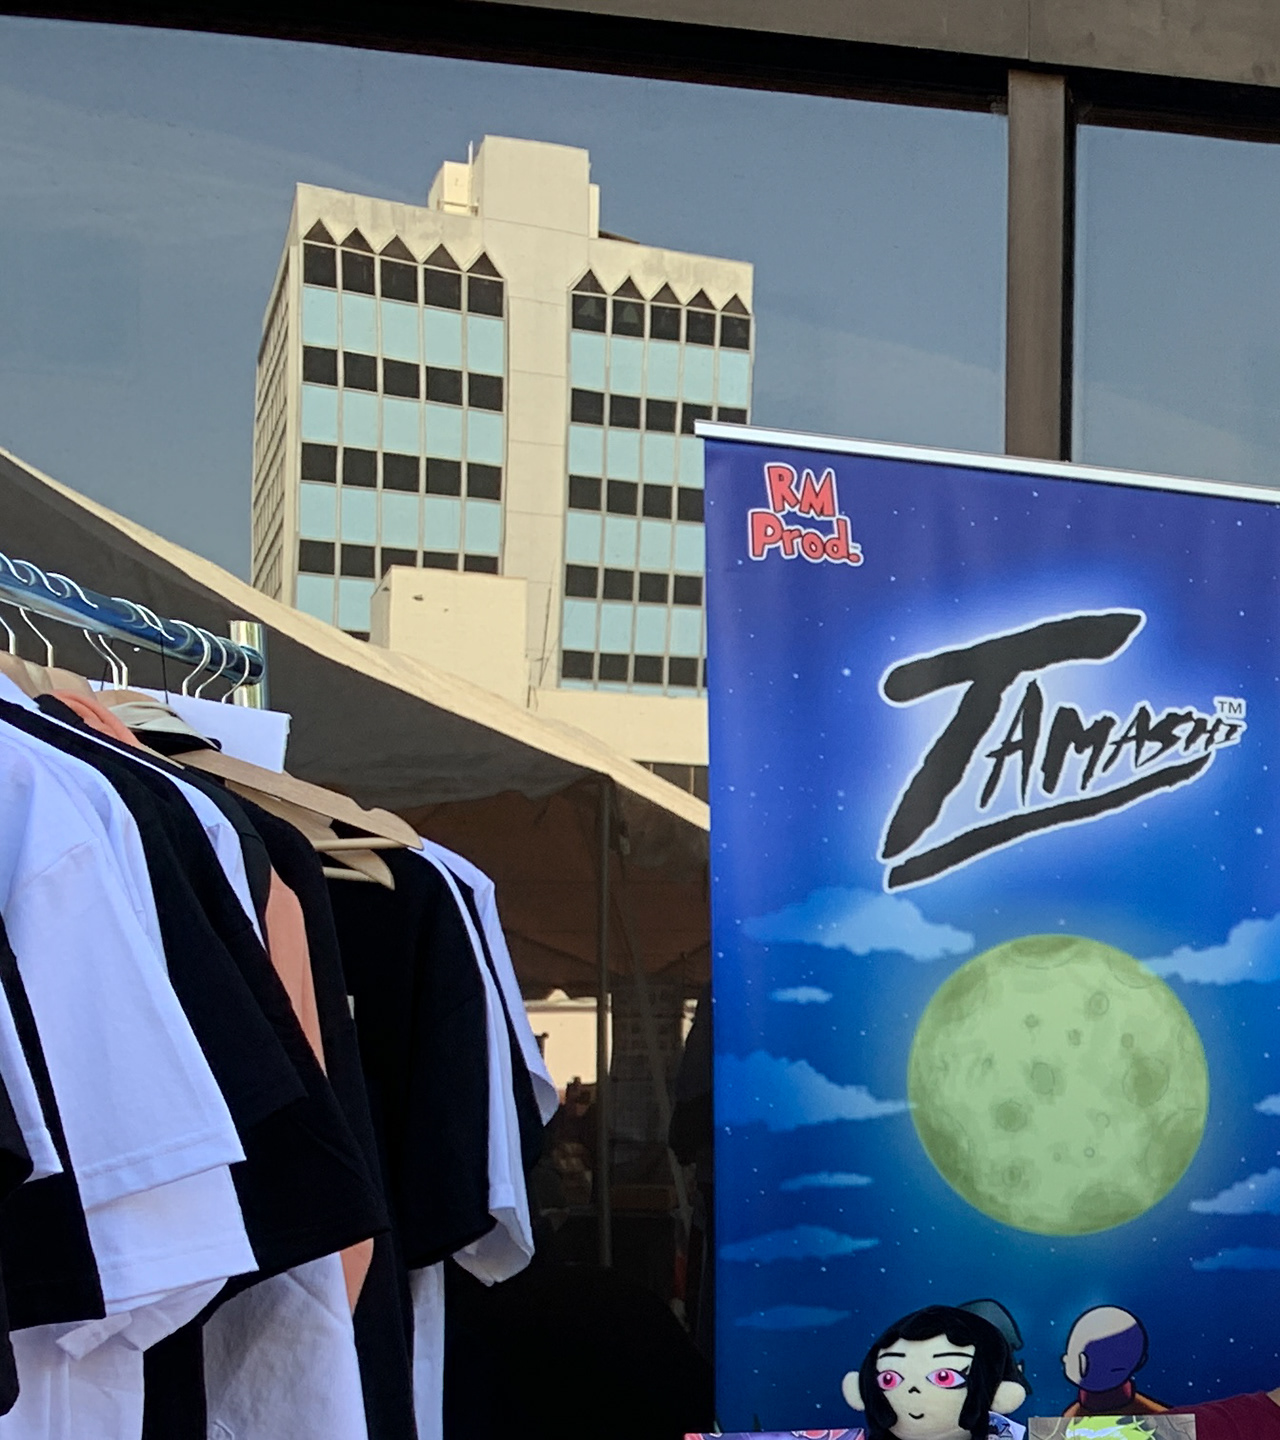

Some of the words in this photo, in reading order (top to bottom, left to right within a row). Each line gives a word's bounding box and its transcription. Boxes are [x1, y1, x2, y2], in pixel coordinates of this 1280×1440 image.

[766, 464, 837, 519] RM
[749, 510, 862, 564] Prod.
[882, 612, 1242, 888] TAMASHI
